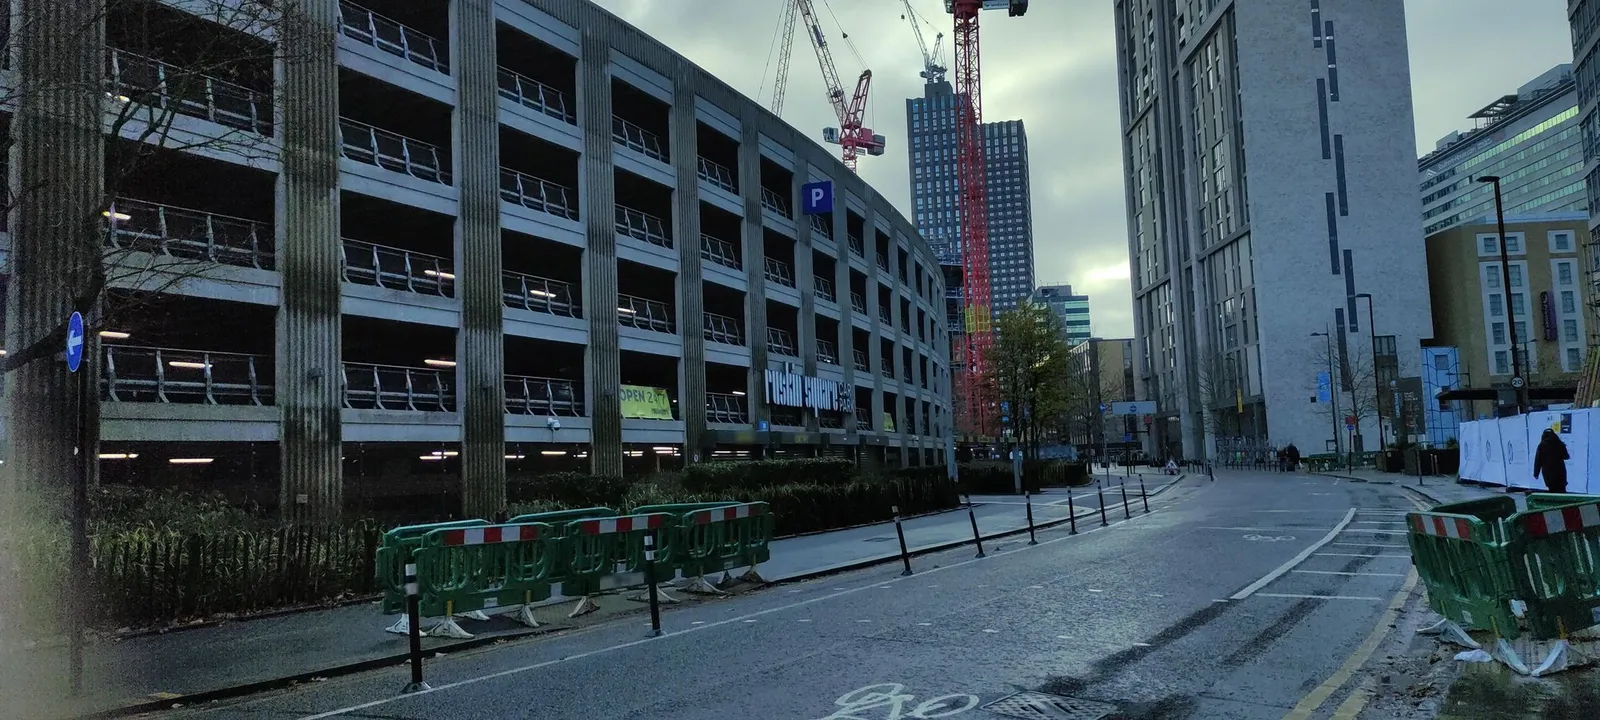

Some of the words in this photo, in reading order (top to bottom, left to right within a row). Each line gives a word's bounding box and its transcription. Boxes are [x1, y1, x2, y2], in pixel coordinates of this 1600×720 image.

[812, 187, 824, 208] P
[620, 388, 645, 403] OPEN
[765, 361, 803, 407] ruskin
[804, 375, 839, 418] square
[838, 381, 852, 397] CAR
[839, 397, 855, 413] PARK
